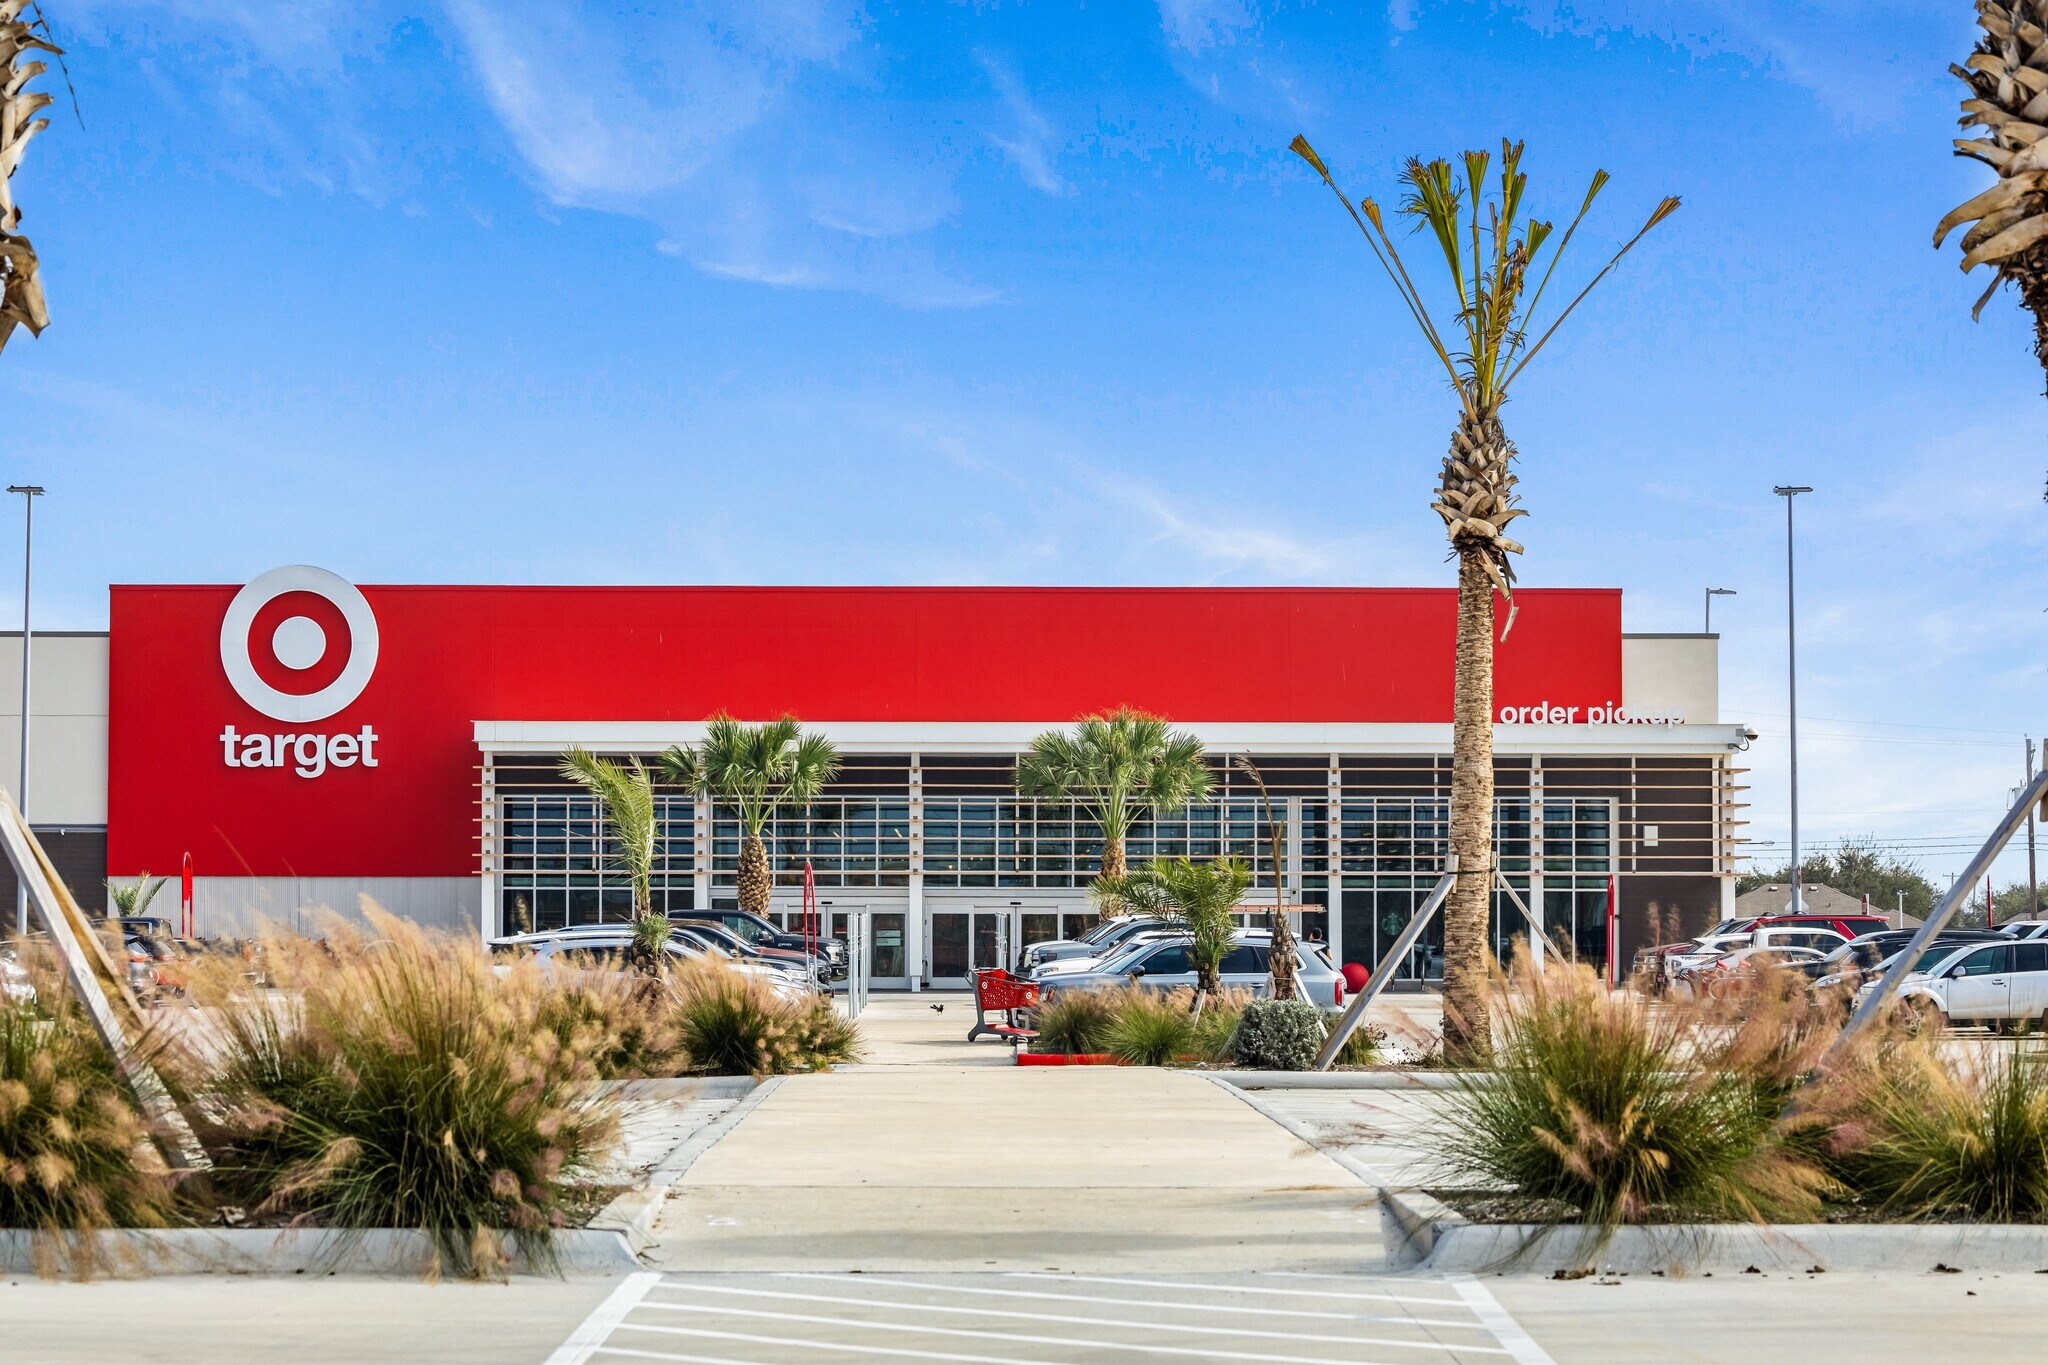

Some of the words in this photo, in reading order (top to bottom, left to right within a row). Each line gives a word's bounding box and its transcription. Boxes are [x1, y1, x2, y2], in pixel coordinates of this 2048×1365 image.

[1500, 701, 1579, 725] order
[1588, 701, 1685, 730] pickup
[219, 725, 379, 779] target
